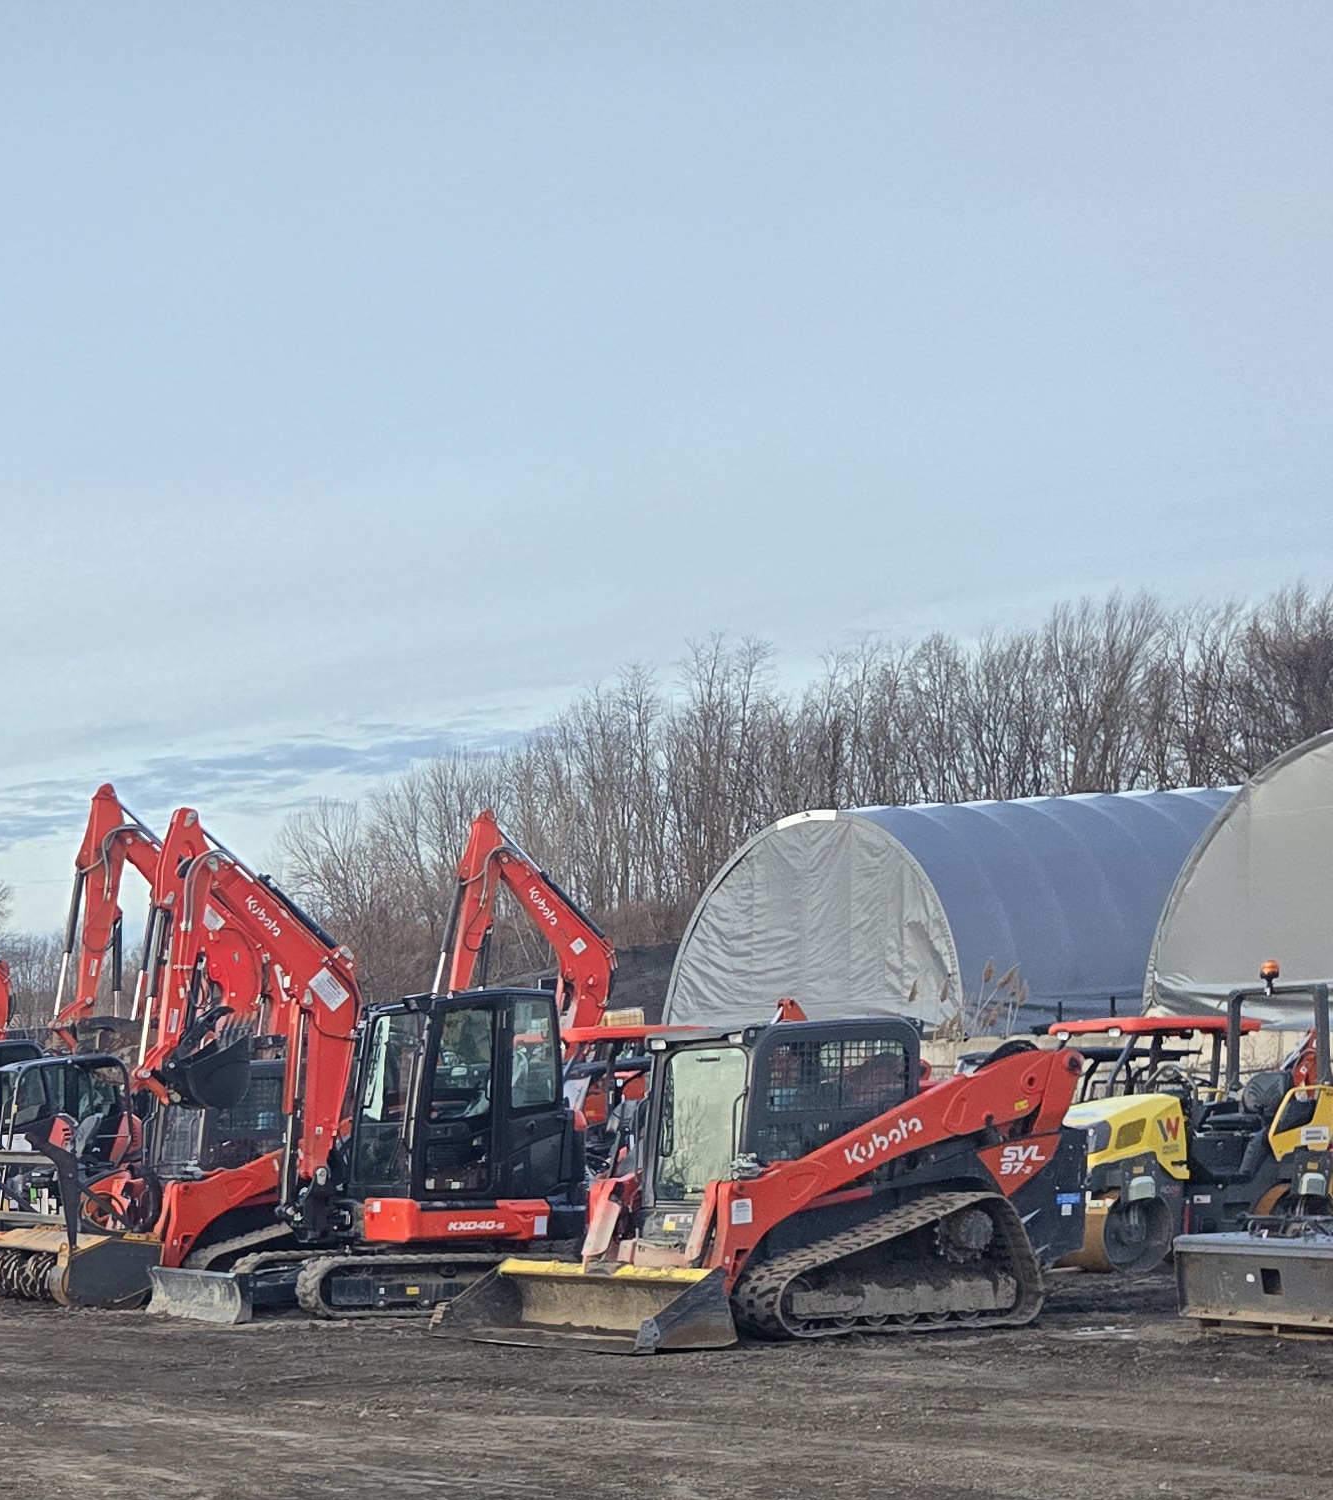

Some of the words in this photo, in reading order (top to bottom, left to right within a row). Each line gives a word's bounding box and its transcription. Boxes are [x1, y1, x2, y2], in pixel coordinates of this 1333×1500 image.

[245, 895, 281, 937] Kubota
[528, 886, 558, 926] Kubota
[844, 1117, 923, 1164] Kubota
[1000, 1145, 1046, 1162] SVL
